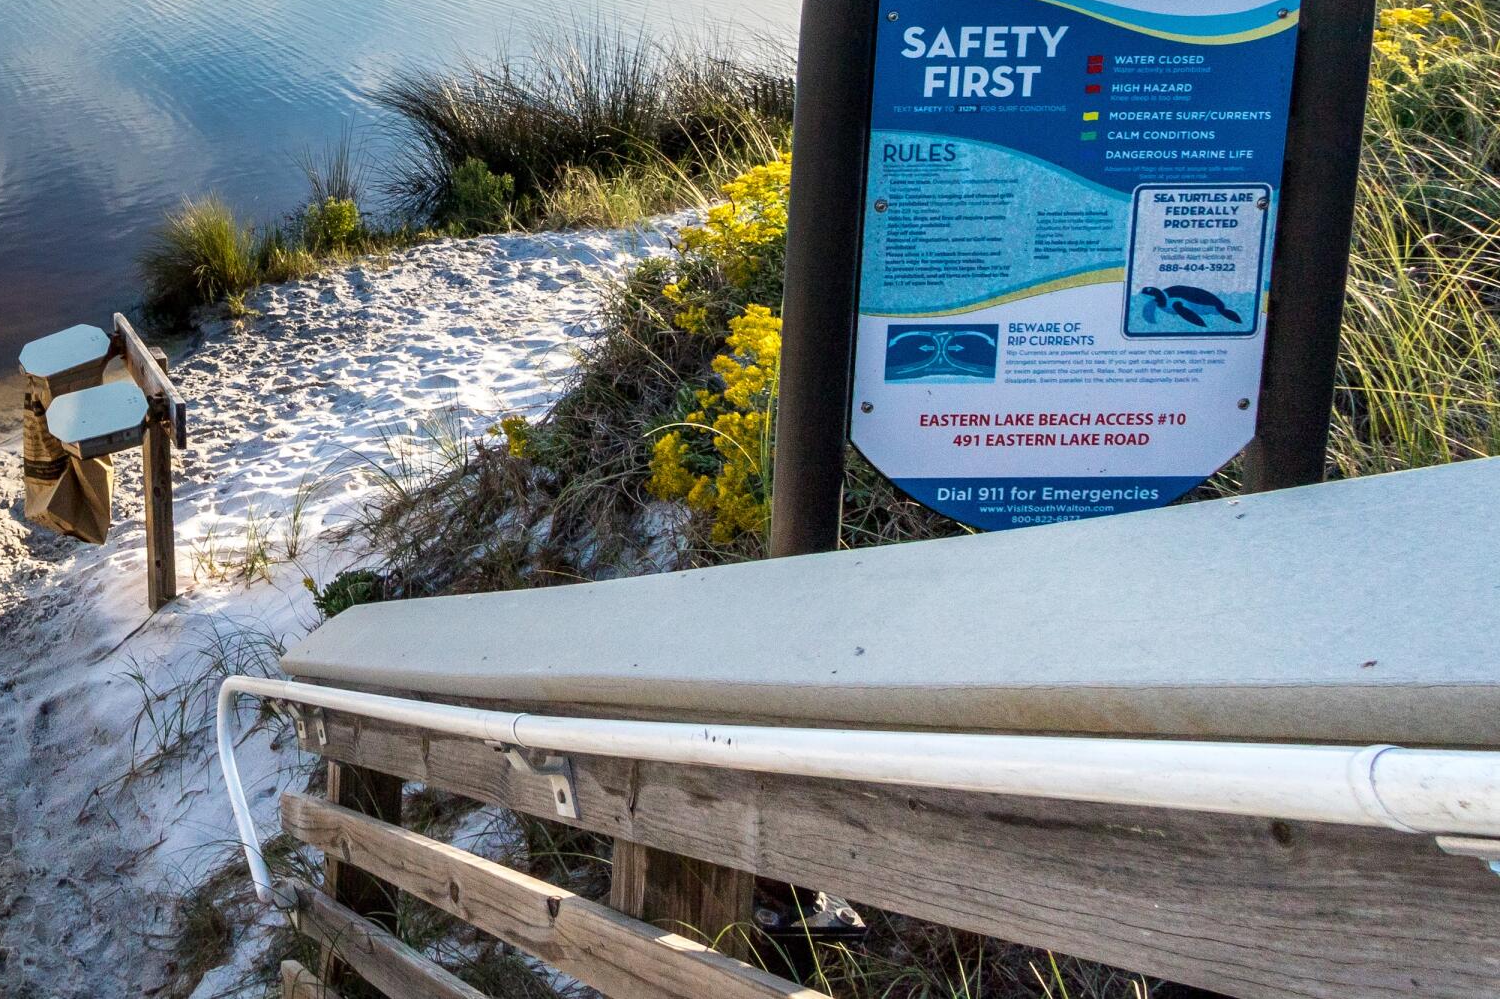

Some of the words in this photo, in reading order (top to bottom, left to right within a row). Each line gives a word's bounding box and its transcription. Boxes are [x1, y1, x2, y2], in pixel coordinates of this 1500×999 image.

[901, 26, 1068, 58] SAFETY
[1115, 56, 1154, 64] WATER
[1158, 56, 1204, 64] CLOSED
[923, 66, 1041, 98] FIRST
[1112, 84, 1139, 92] HIGH
[1110, 112, 1172, 120] MODERATE
[1176, 111, 1271, 121] SURF/CURRENTS
[1143, 131, 1215, 139] CONDITIONS
[883, 143, 956, 163] RULES
[1106, 151, 1178, 159] DANGEROUS
[1181, 150, 1225, 159] MARINE
[1154, 194, 1175, 202] SEA
[1178, 194, 1227, 202] TURTLES
[1230, 193, 1253, 202] ARE
[1166, 207, 1239, 215] FEDERALLY
[1164, 219, 1238, 228] PROTECTED
[1009, 323, 1060, 332] BEWARE
[1064, 323, 1081, 332] OF
[1008, 336, 1026, 345] RIP
[1029, 336, 1094, 345] CURRENTS
[920, 414, 990, 427] EASTERN
[994, 414, 1034, 426] LAKE
[1039, 414, 1090, 426] BEACH
[1096, 413, 1153, 425] ACCESS
[1157, 413, 1186, 425] #10
[953, 434, 980, 447] 491
[986, 434, 1056, 446] EASTERN
[1060, 434, 1100, 446] LAKE
[1105, 433, 1149, 446] ROAD
[937, 488, 972, 500] Dial
[978, 488, 1004, 500] 911
[1010, 486, 1034, 500] for
[1042, 486, 1159, 502] Emergencies
